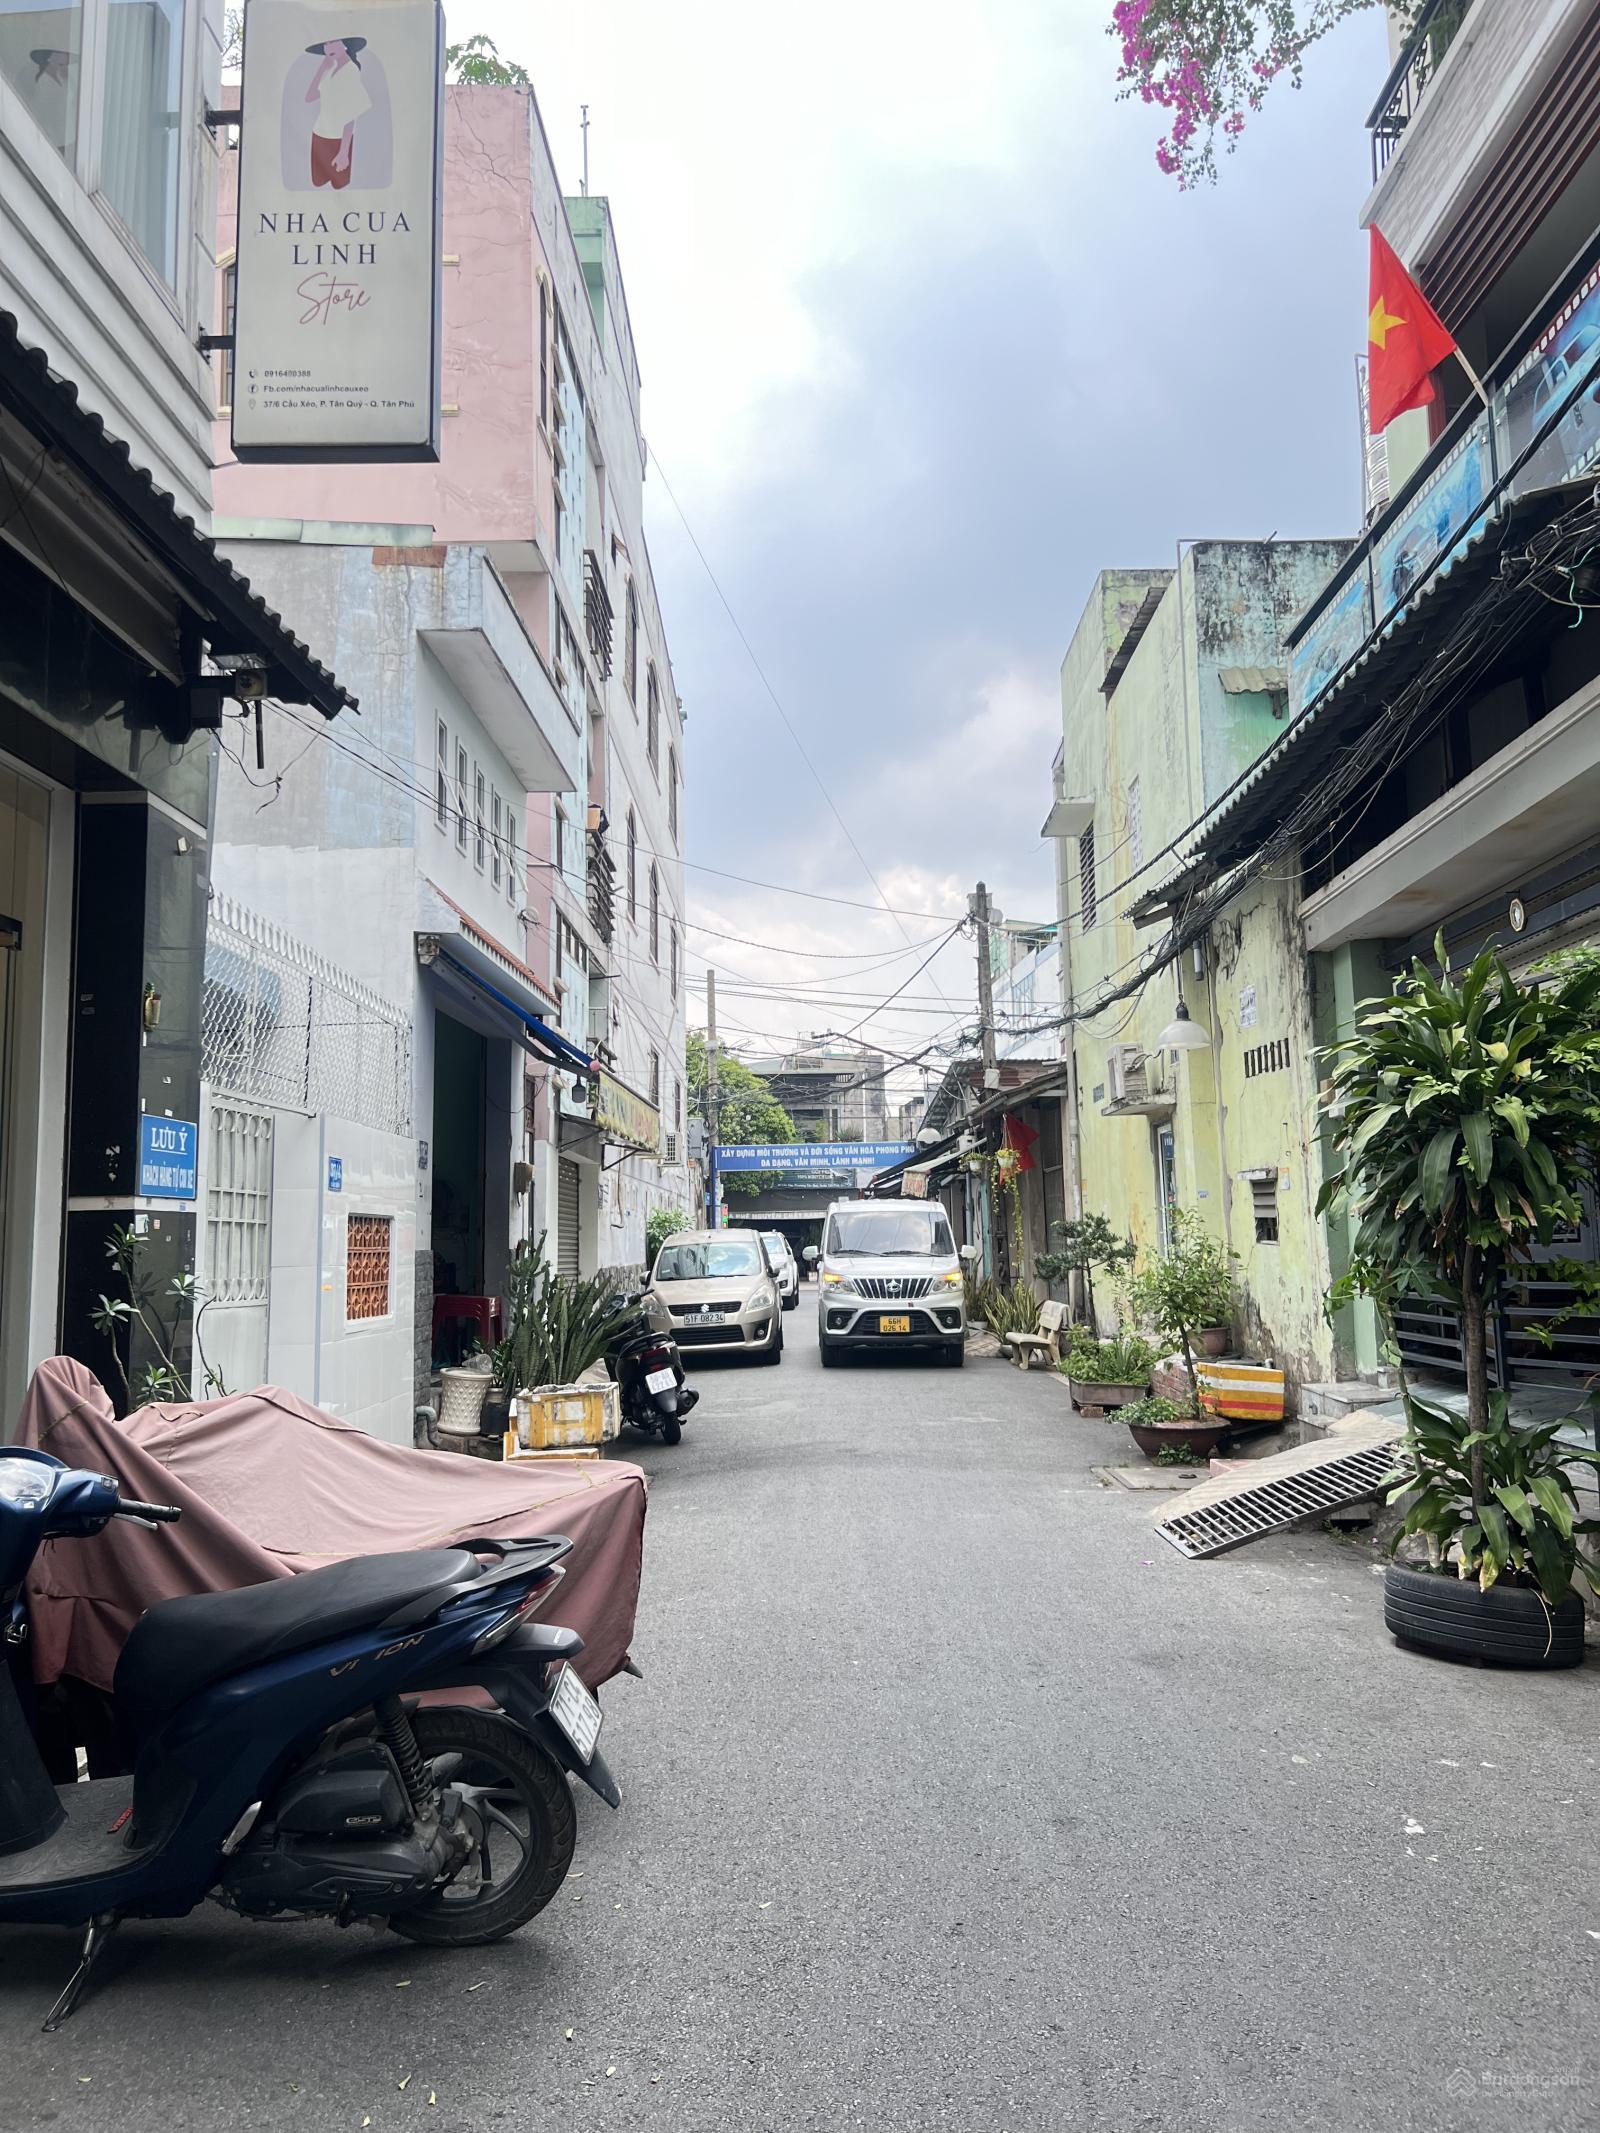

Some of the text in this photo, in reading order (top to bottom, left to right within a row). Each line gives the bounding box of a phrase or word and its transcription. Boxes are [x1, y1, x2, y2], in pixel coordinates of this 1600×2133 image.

[258, 211, 411, 234] NHA CUA
[291, 244, 377, 265] LINH
[296, 271, 372, 326] Store
[151, 1126, 188, 1151] LƯU Ý
[721, 1147, 735, 1158] XÂY
[875, 1145, 899, 1154] PHONG
[685, 1314, 698, 1324] 51F
[888, 1317, 902, 1325] 66H
